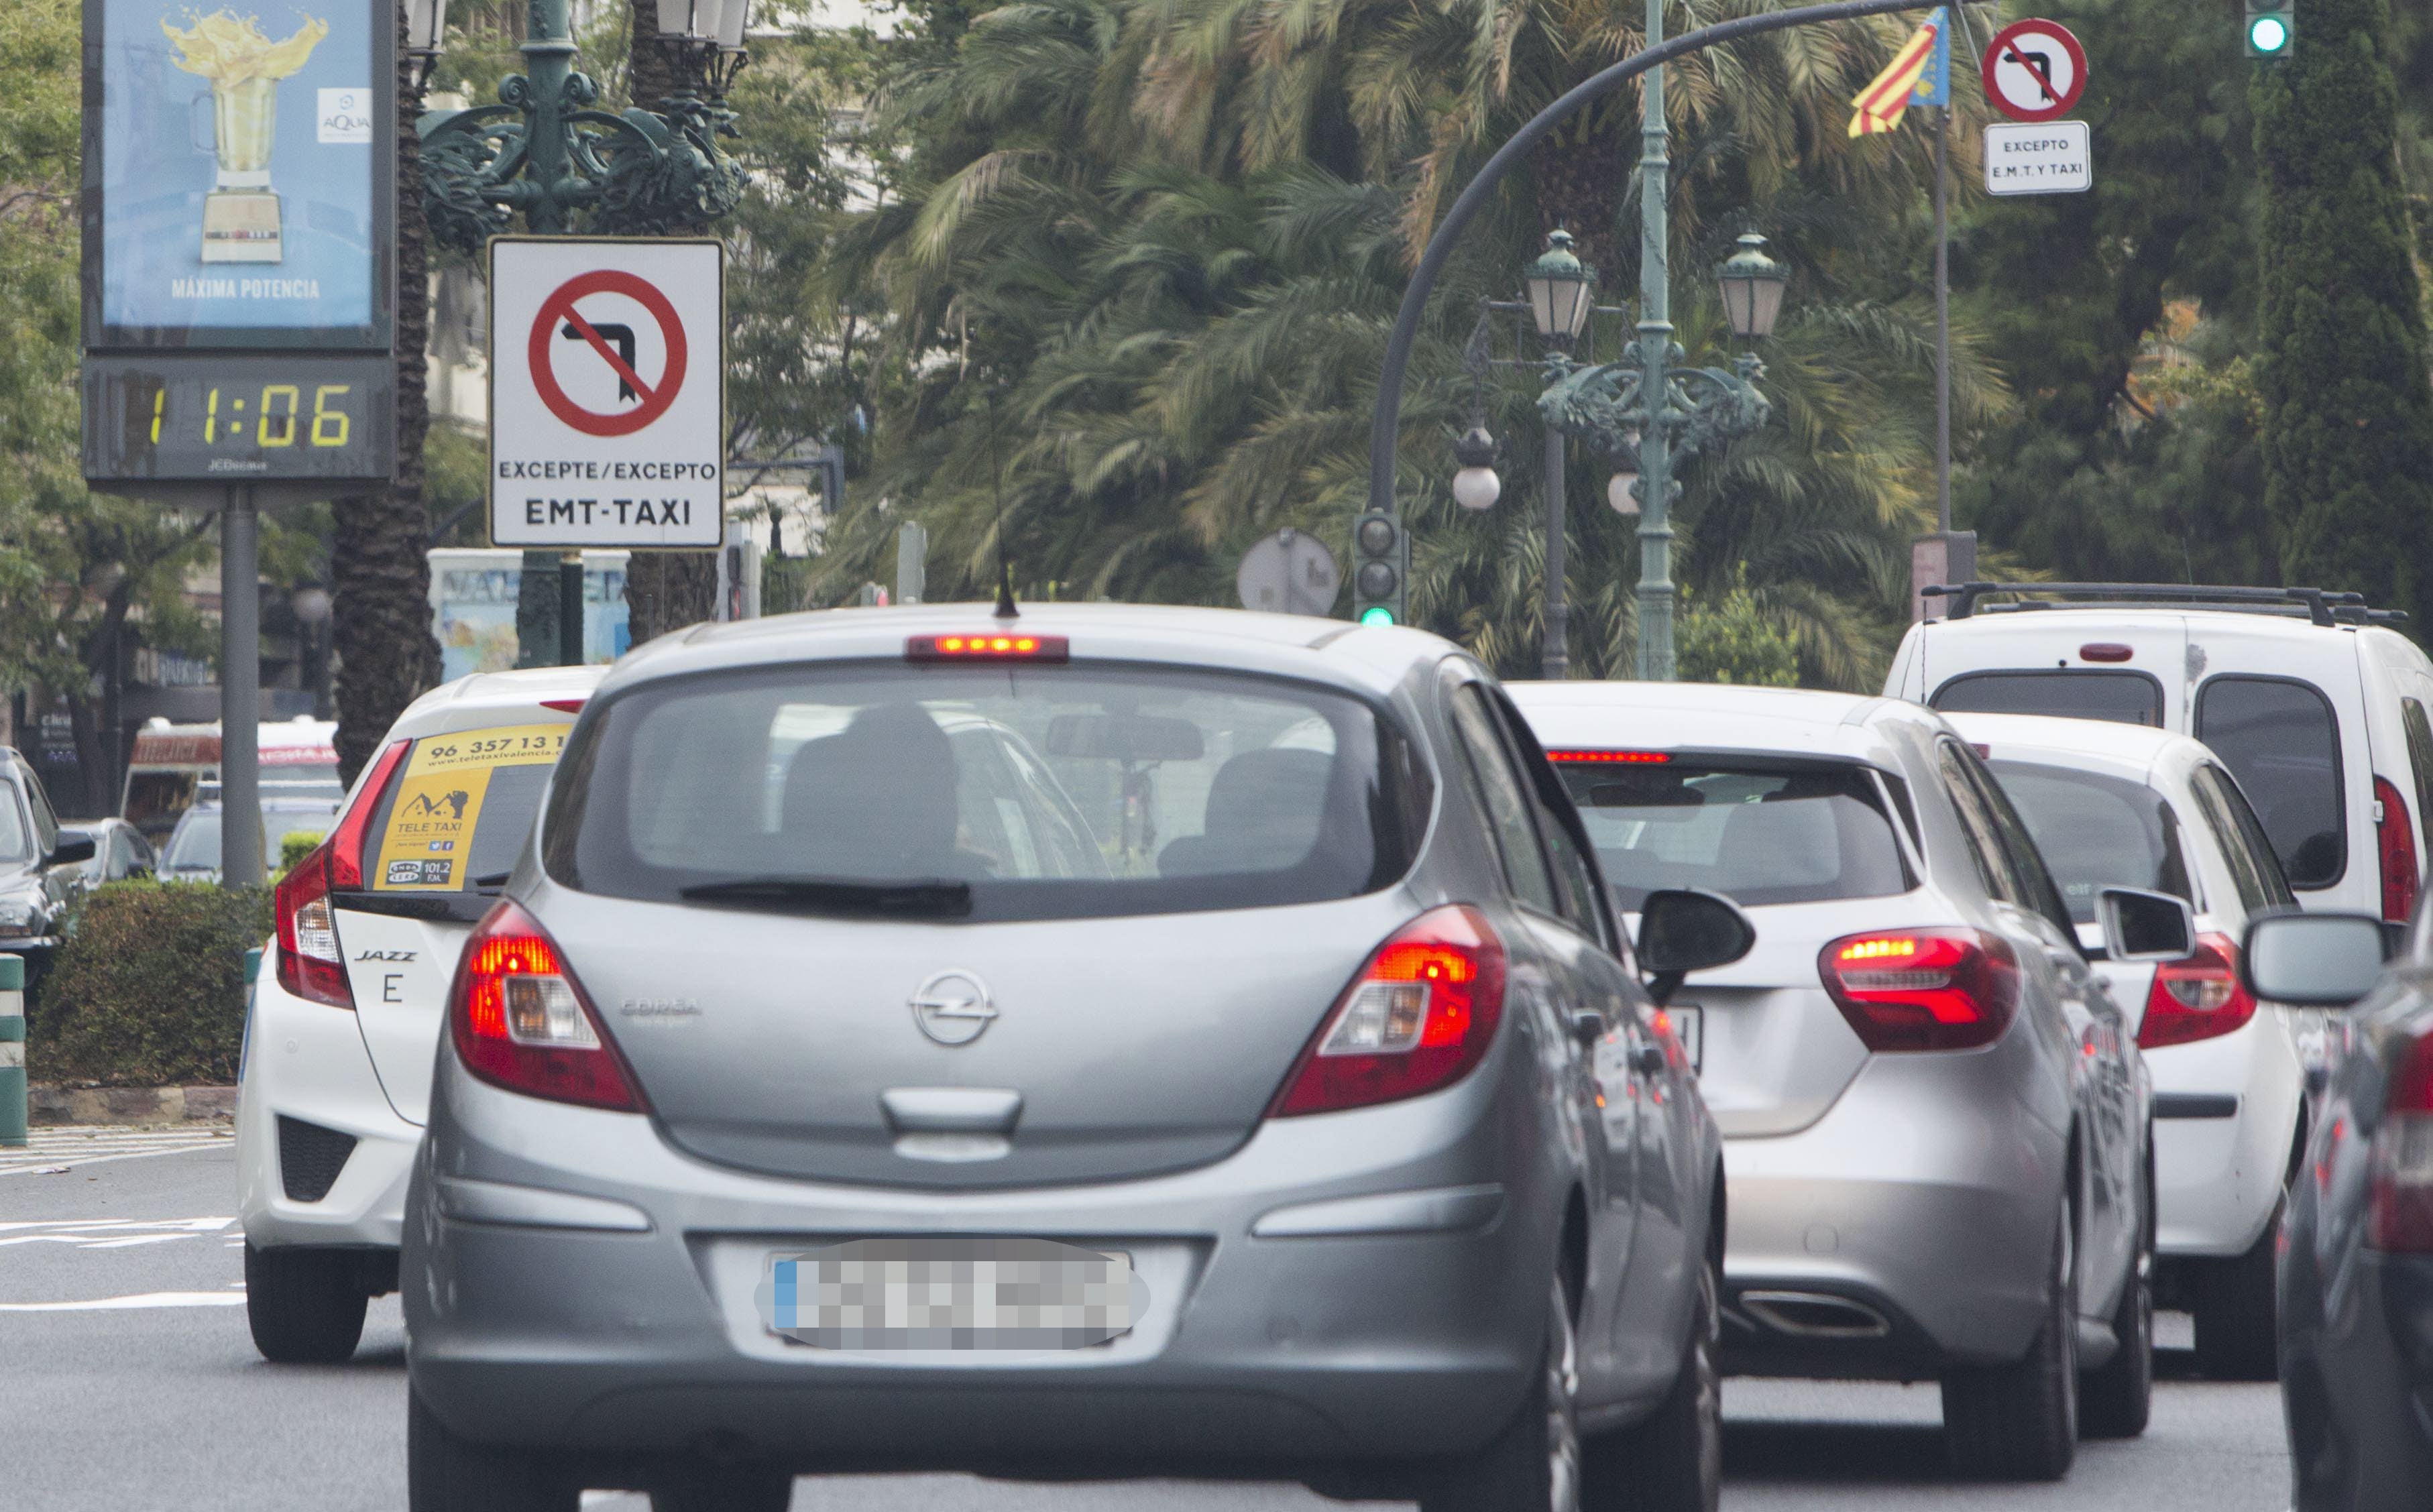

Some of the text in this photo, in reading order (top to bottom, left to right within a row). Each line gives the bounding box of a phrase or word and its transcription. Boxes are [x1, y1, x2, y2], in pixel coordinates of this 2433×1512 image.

[323, 114, 371, 131] AQUA
[2004, 139, 2069, 153] EXCEPTO
[2037, 165, 2045, 176] Y
[2050, 164, 2082, 174] TAXI
[172, 276, 320, 298] MÁXIMA POTENCIA
[150, 384, 350, 447] 11:06
[499, 461, 716, 480] EXCEPTE/EXCEPTO
[526, 499, 690, 525] EMT-TAXI
[431, 745, 458, 759] 96
[470, 738, 513, 754] 357
[522, 736, 547, 749] 13
[398, 822, 462, 833] TELE TAXI
[425, 862, 451, 874] 101.2
[354, 950, 418, 962] JAZZ
[384, 974, 404, 1002] E
